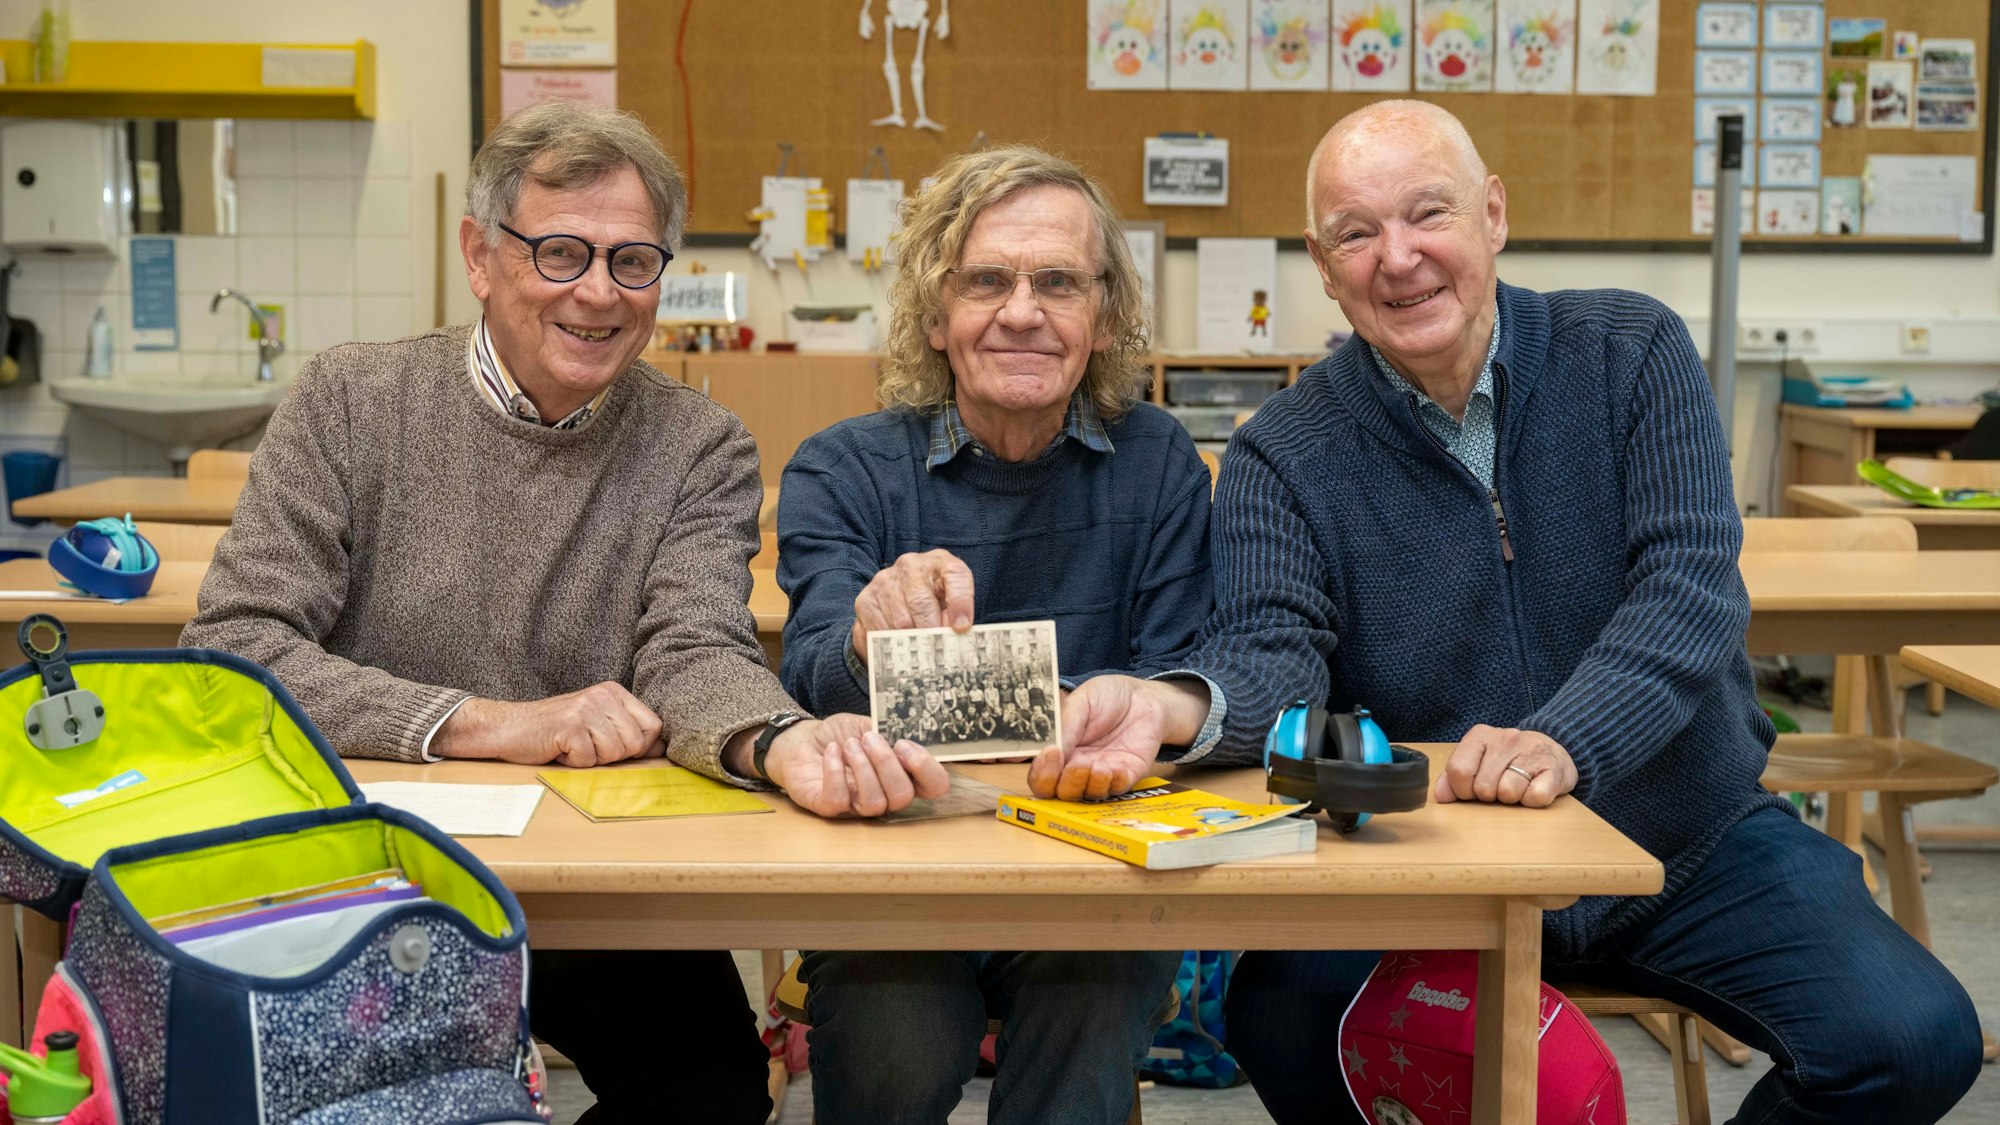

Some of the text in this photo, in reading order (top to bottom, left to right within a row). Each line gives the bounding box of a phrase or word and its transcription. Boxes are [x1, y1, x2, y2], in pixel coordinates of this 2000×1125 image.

[1047, 821, 1129, 855] Das Grundschulwörterbuch
[1407, 980, 1471, 1012] ergobag
